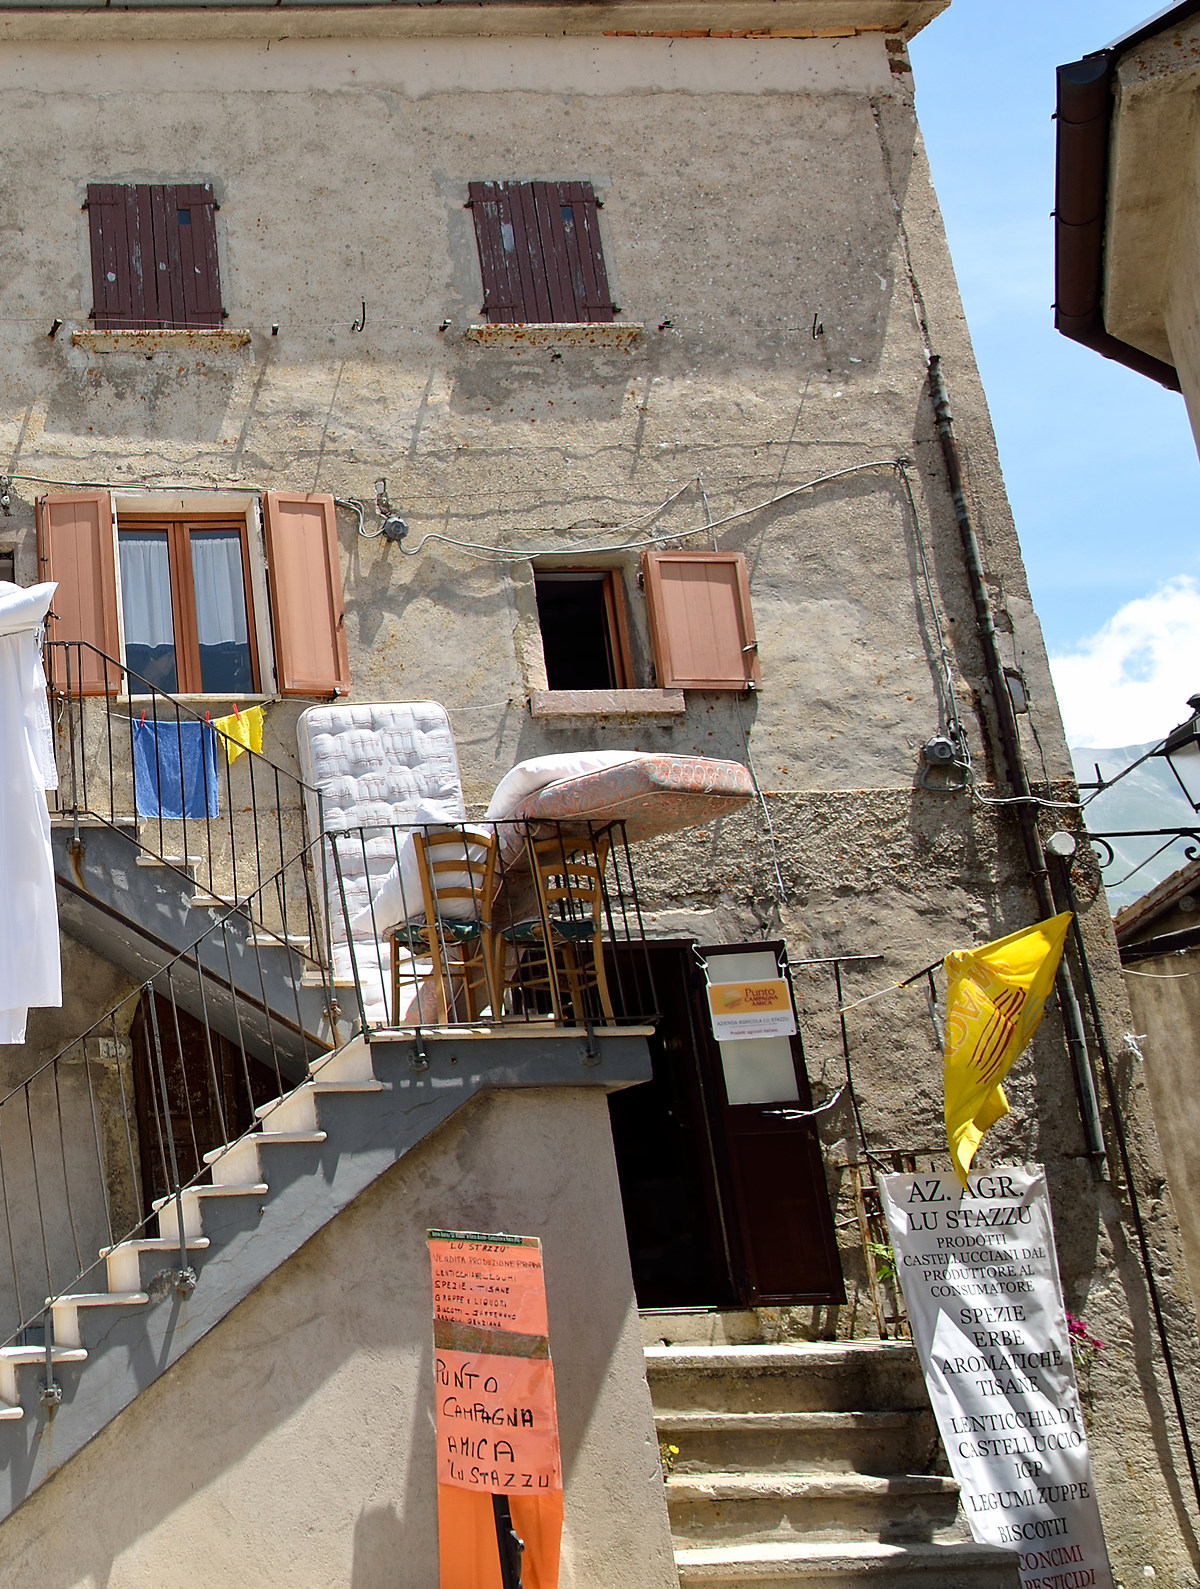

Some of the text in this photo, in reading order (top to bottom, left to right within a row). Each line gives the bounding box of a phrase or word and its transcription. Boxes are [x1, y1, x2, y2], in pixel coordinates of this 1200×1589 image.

[745, 988, 775, 997] Punto
[907, 1176, 1024, 1203] AZ. AGR.
[908, 1206, 1032, 1231] LU STAZZU
[936, 1234, 1007, 1248] PRODOTTI
[433, 1253, 466, 1264] VENDITA
[903, 1248, 1046, 1266] CASTELLUCCIANI DAL
[923, 1264, 1035, 1281] PRODUTTORE AL
[435, 1280, 466, 1290] SPEZIE
[930, 1281, 1034, 1298] CONSUMATORE
[474, 1298, 507, 1308] LIQUORI
[960, 1305, 1026, 1325] SPEZIE
[974, 1330, 1024, 1347] ERBE
[941, 1350, 1063, 1374] AROMATICHE
[436, 1358, 498, 1393] PUNTO
[976, 1376, 1040, 1396] TISANE
[443, 1396, 534, 1428] CAMPAGNA
[951, 1407, 1078, 1434] LENTICCHIA DI
[448, 1436, 515, 1462] AMICA
[959, 1431, 1082, 1458] CASTELLUCCIO
[1014, 1461, 1043, 1479] IGP
[969, 1482, 1090, 1512] LEGUMI ZUPPE
[998, 1517, 1068, 1543] BISCOTTI
